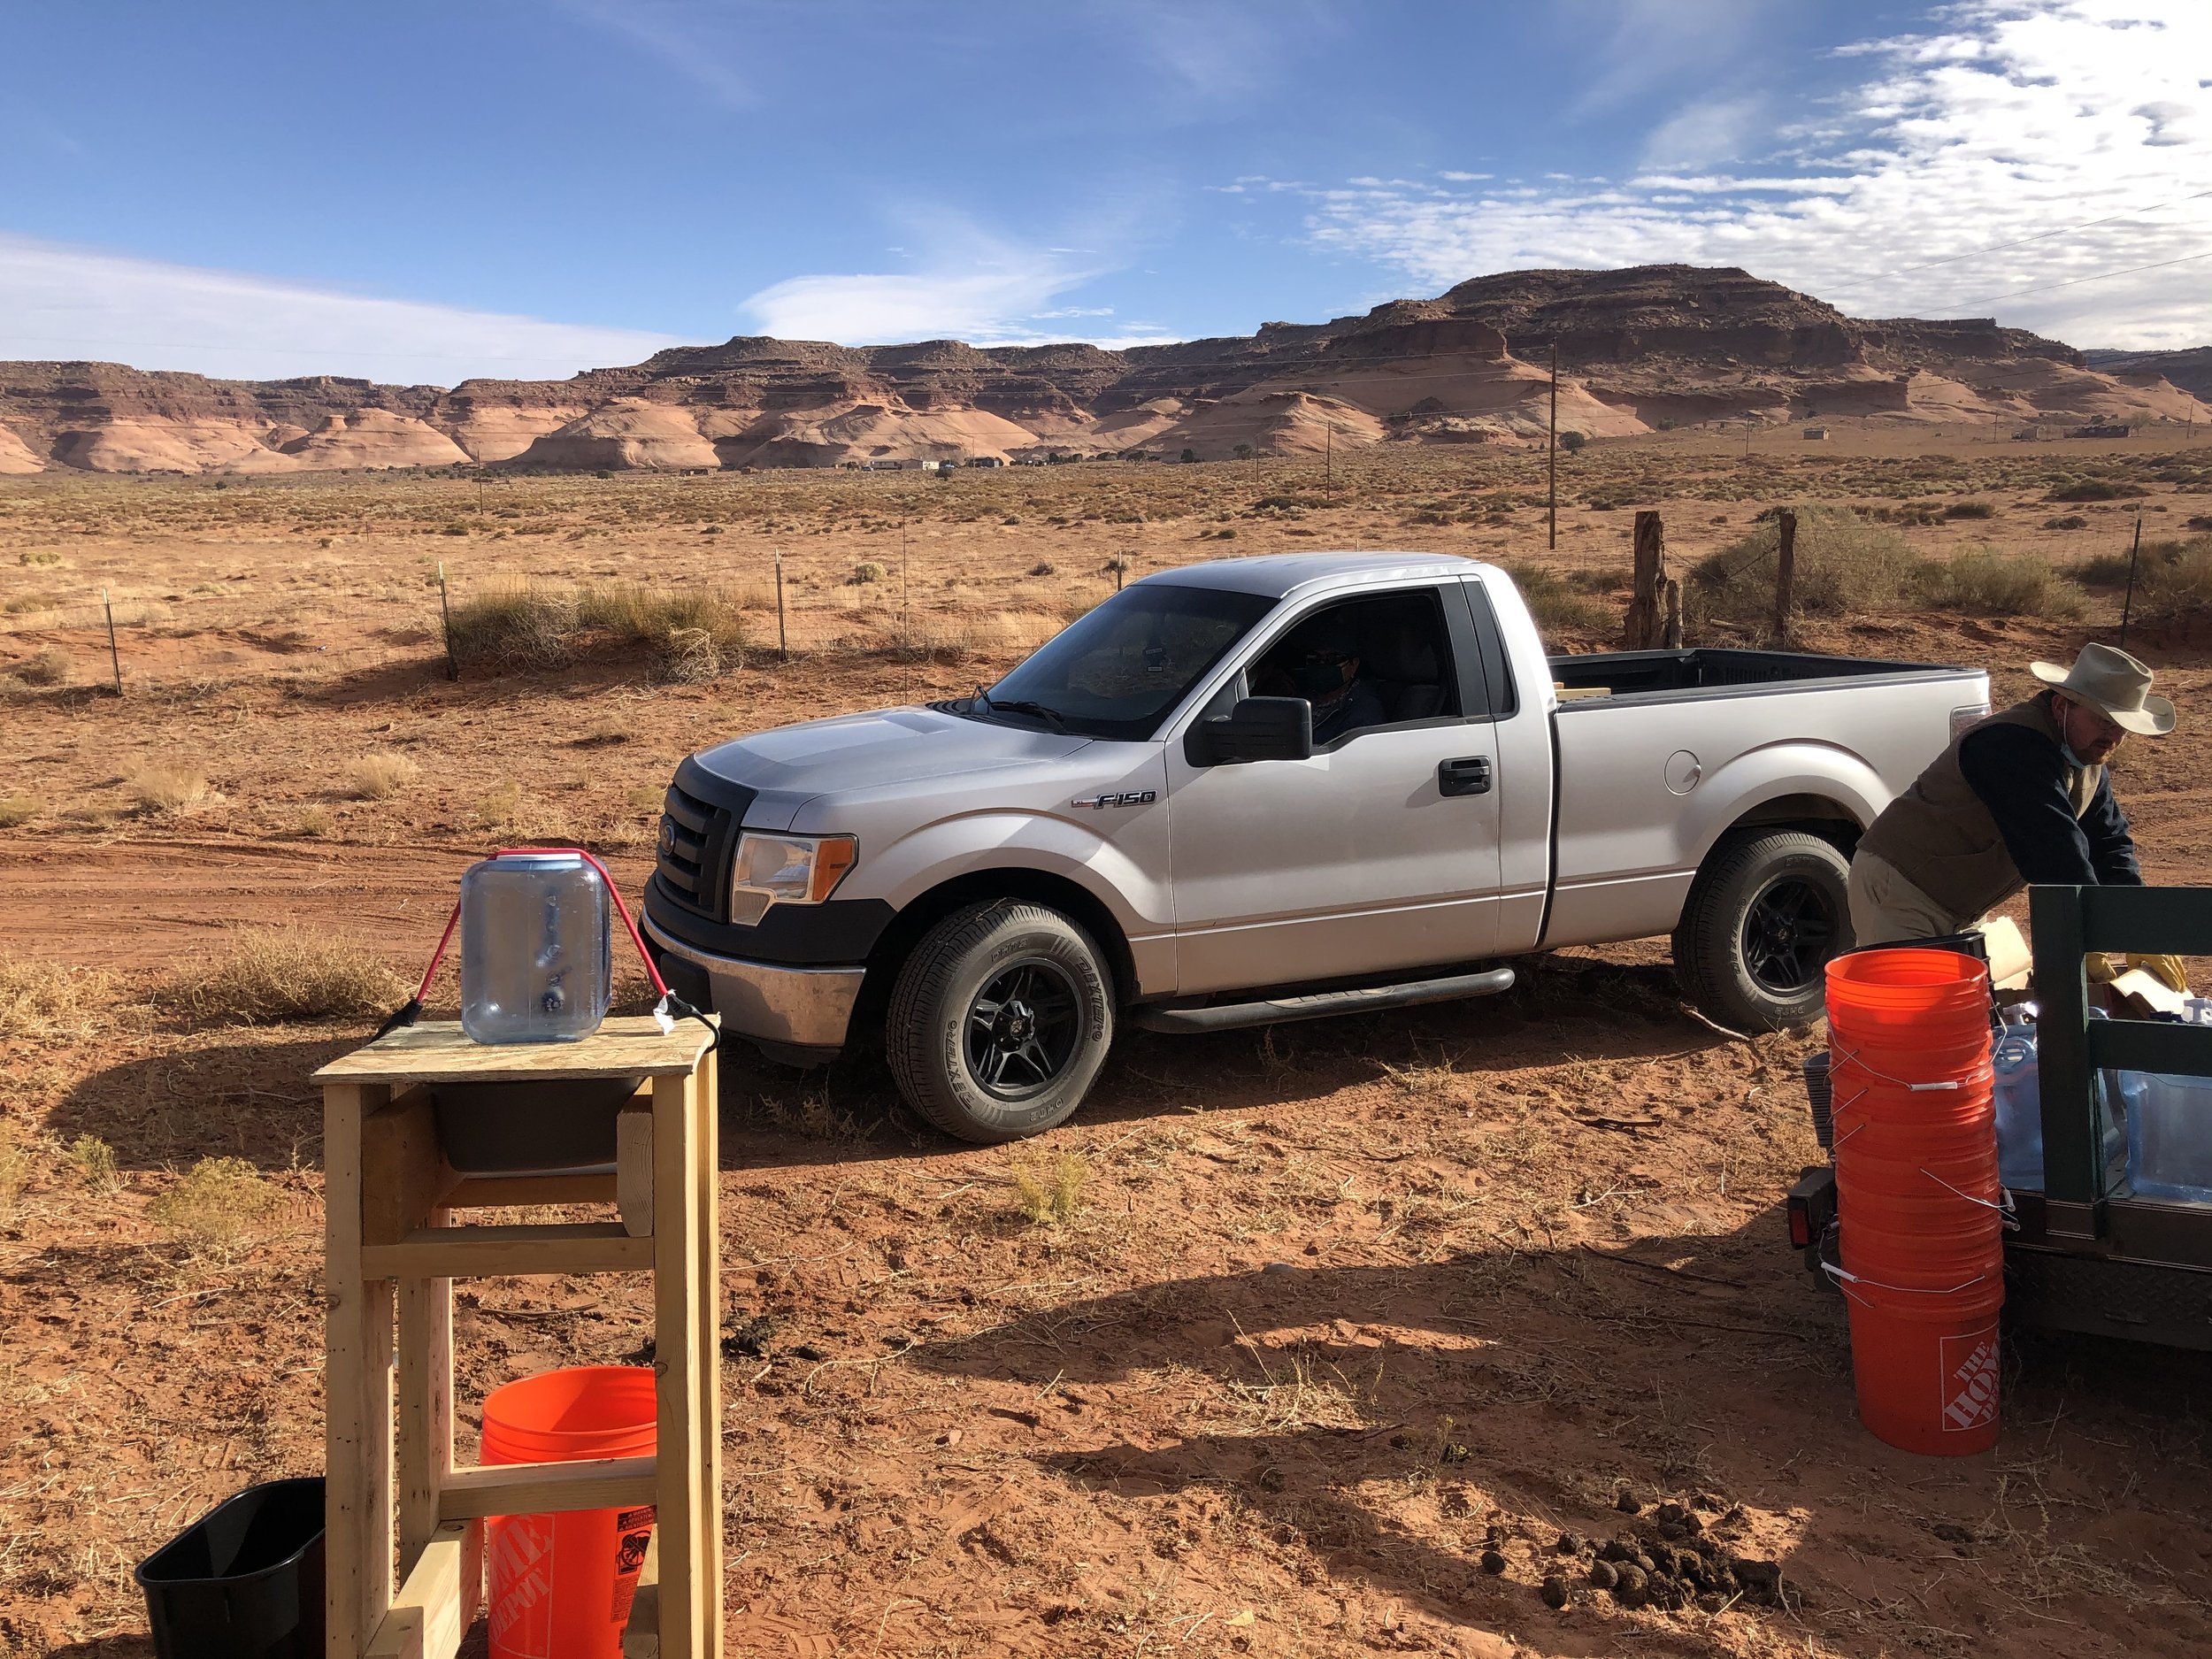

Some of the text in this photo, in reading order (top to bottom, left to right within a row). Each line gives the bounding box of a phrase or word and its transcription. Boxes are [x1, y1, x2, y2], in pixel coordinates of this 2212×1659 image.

[1094, 790, 1157, 810] F-150
[1077, 956, 1105, 1042] DEXTERO
[946, 1019, 974, 1110] DEXTERO
[1953, 1340, 1990, 1383] THE
